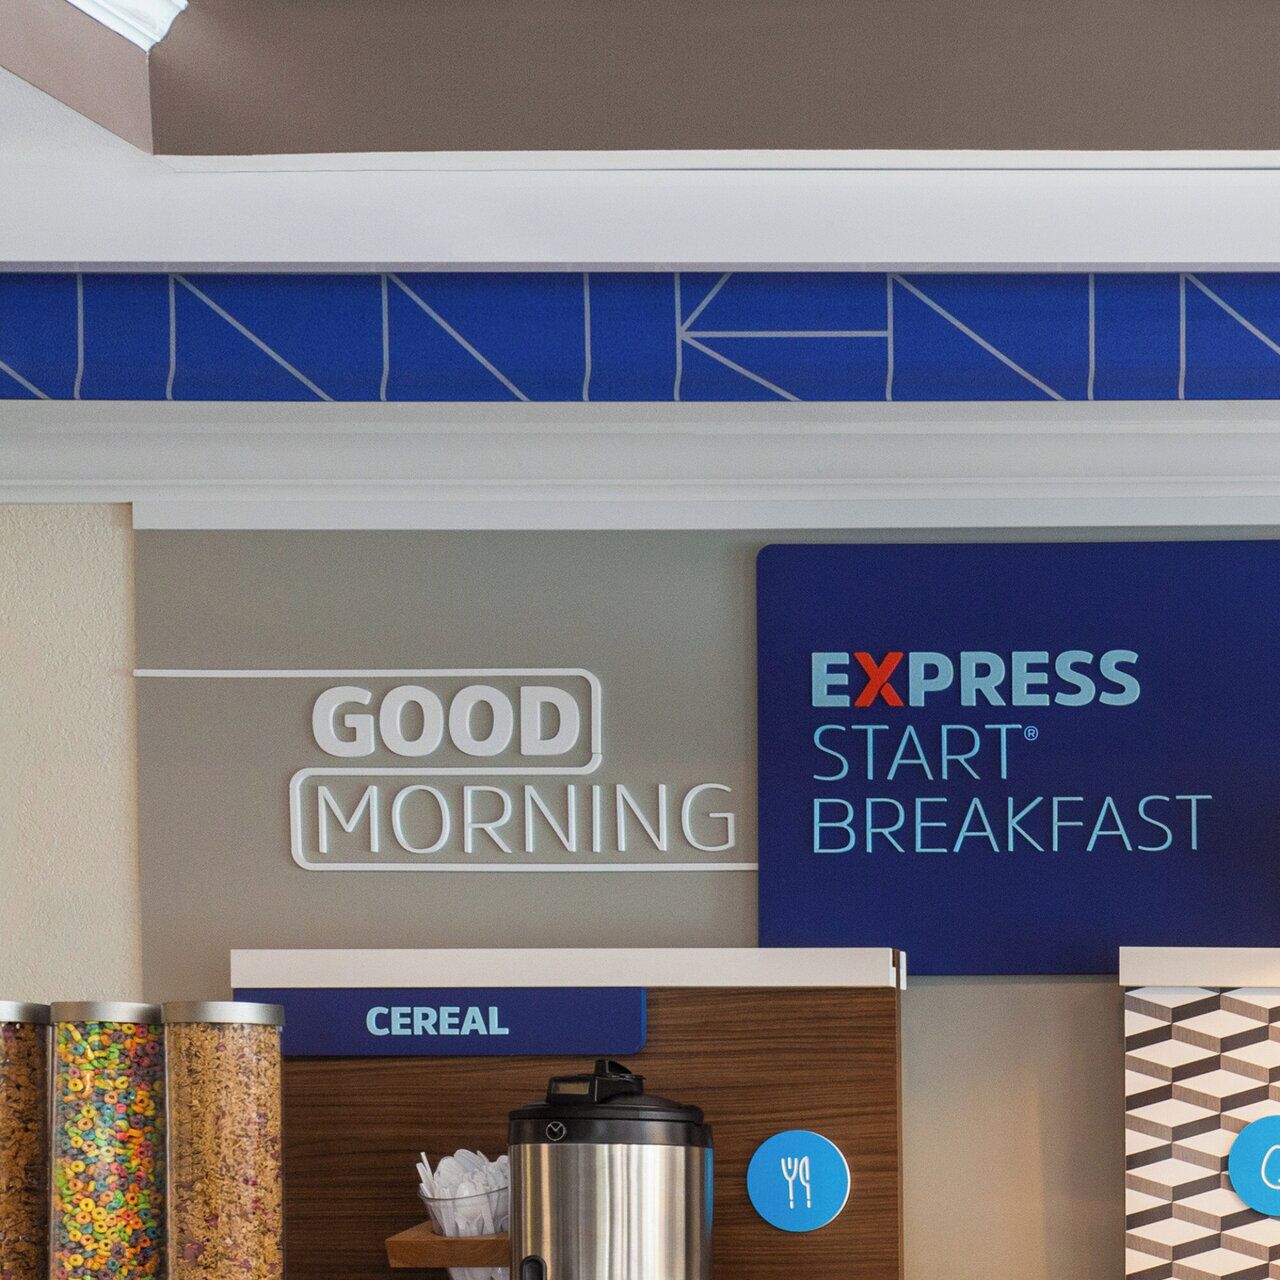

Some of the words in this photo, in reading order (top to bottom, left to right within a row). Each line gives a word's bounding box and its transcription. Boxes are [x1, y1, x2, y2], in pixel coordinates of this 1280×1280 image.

[810, 649, 1141, 709] EXPRESS
[312, 685, 580, 758] GOOD
[316, 782, 737, 855] MORNING
[813, 794, 1213, 855] BREAKFAST
[365, 1006, 510, 1036] CEREAL
